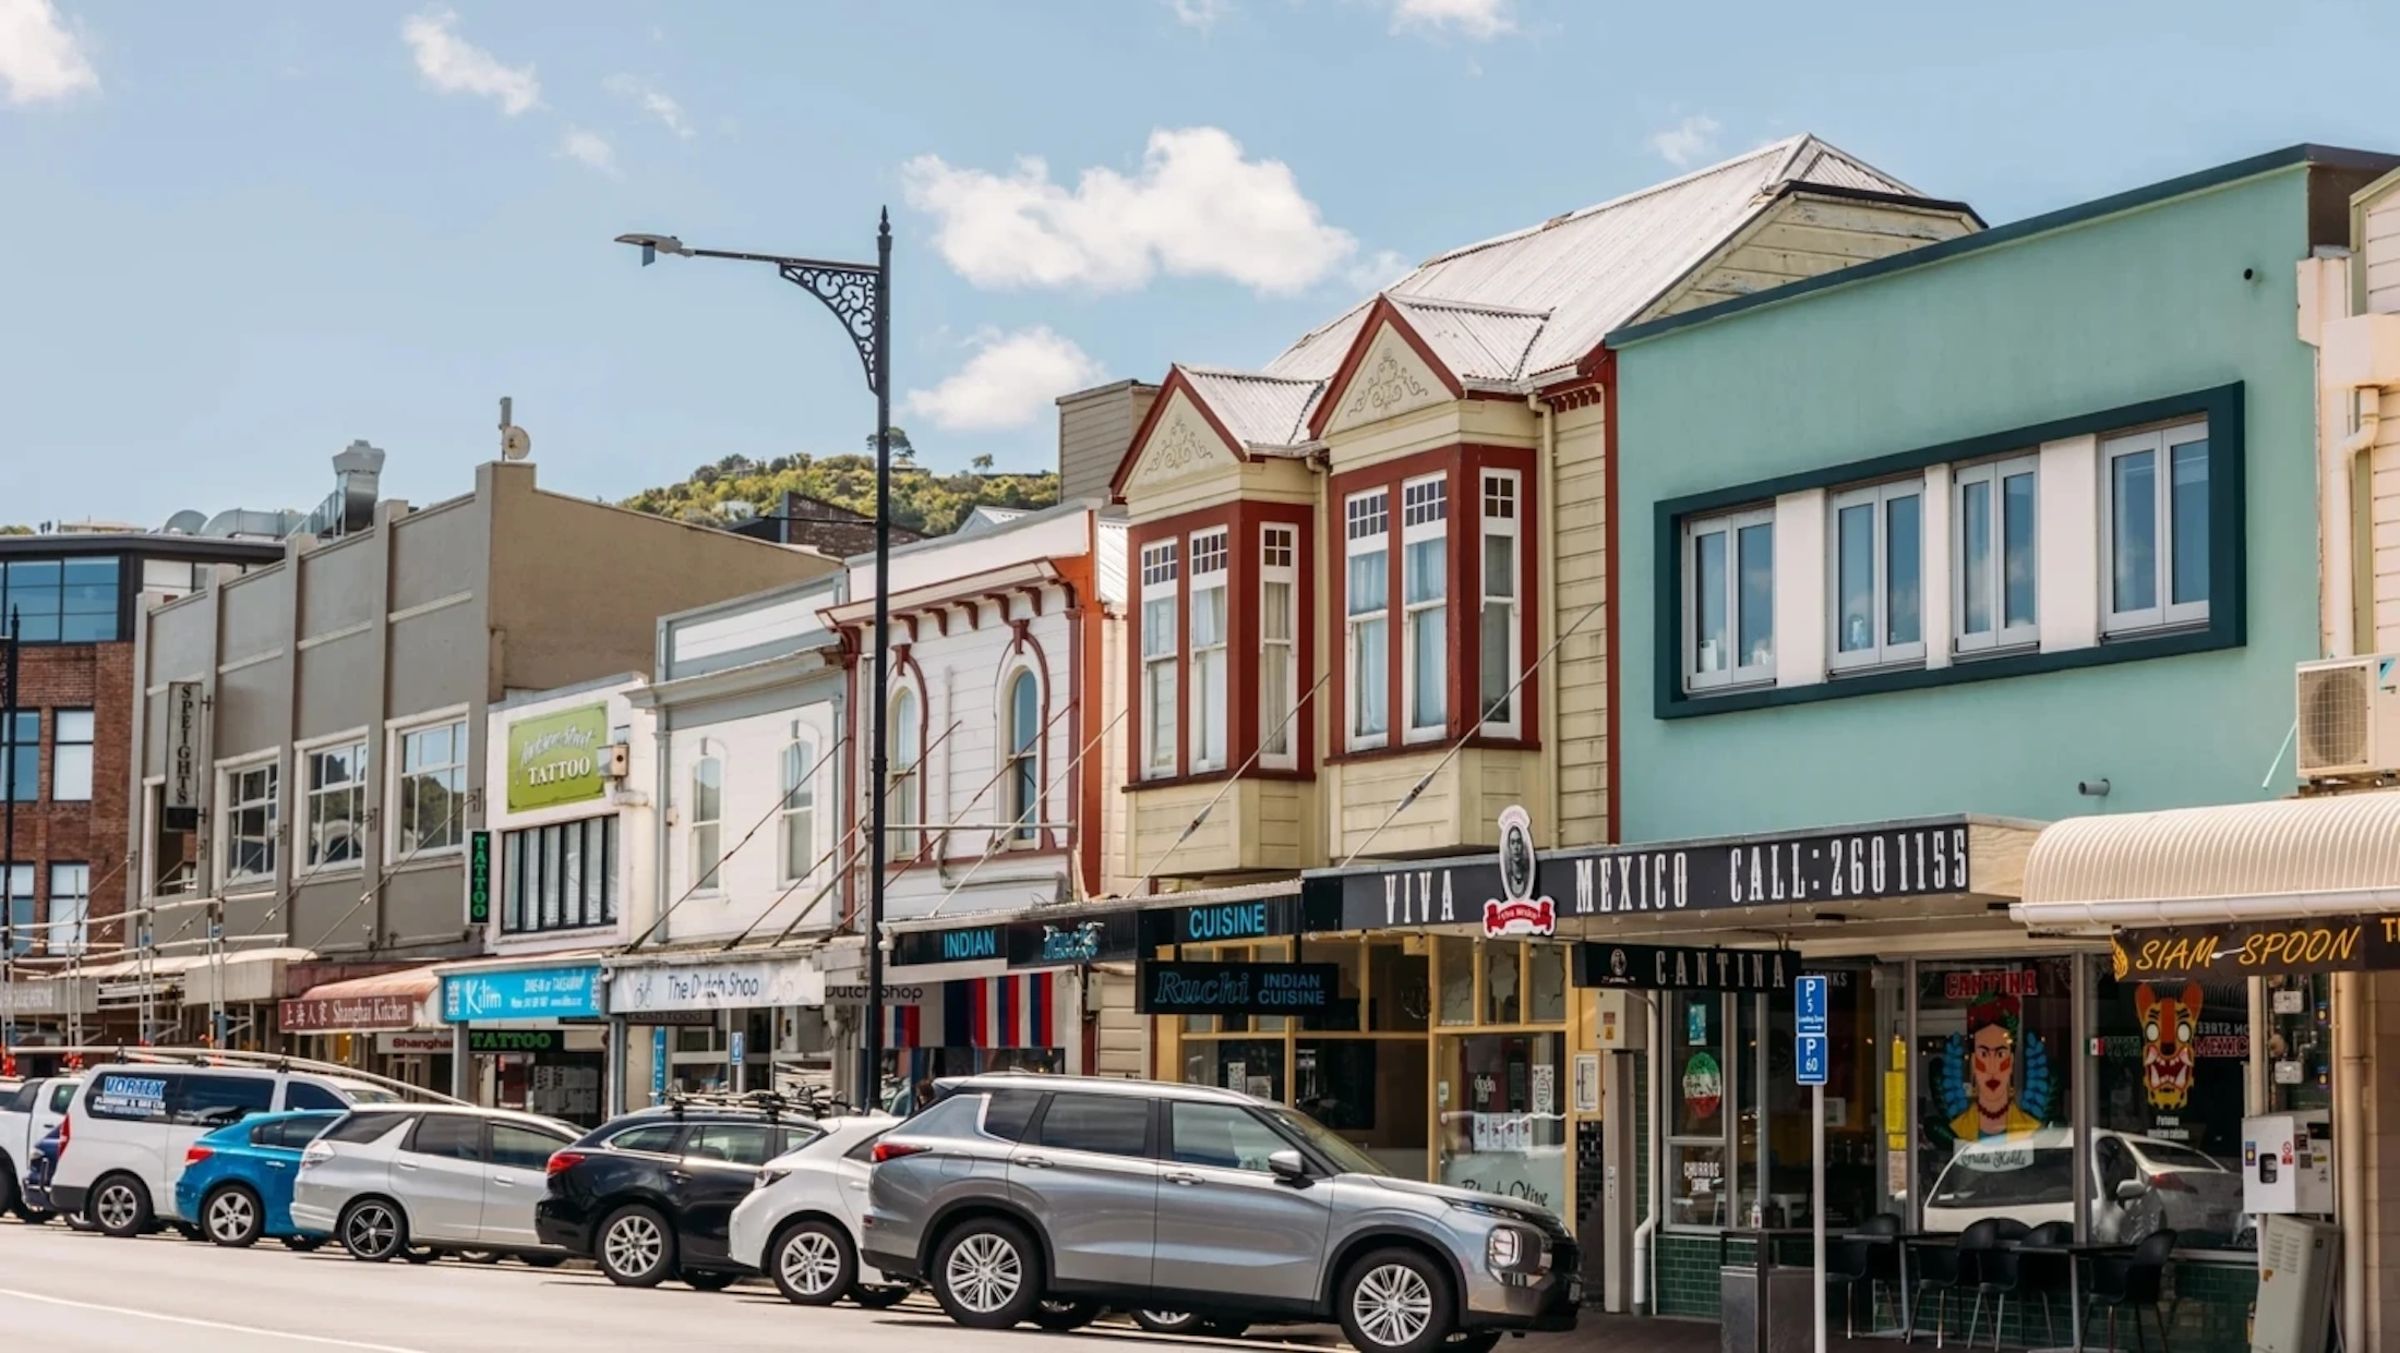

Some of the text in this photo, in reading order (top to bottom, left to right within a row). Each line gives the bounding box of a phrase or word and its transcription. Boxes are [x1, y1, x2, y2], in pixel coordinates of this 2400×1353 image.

[176, 685, 193, 804] SPEIGHTS
[528, 757, 592, 787] TATTOO
[473, 835, 487, 918] TATTOO
[1384, 870, 1454, 924] VIVA
[1576, 852, 1687, 913] MEXICO
[1188, 903, 1265, 939] CUISINE
[2381, 918, 2400, 942] T
[944, 930, 995, 959] INDIAN
[2136, 925, 2361, 971] SIAM SPOON
[1263, 973, 1321, 988] INDIAN
[1656, 950, 1786, 988] CANTINA
[466, 978, 502, 1015] Kilim
[668, 975, 689, 1000] The
[728, 970, 760, 999] Shop
[1154, 971, 1250, 1005] Ruchi
[1257, 991, 1326, 1005] CUISINE
[1805, 980, 1816, 998] P
[1944, 970, 2039, 999] CANTINA
[332, 998, 408, 1026] Shanghai Kitchen
[1807, 998, 1814, 1013] 5
[471, 1032, 551, 1049] TATTOO
[1806, 1038, 1817, 1056] P
[1805, 1057, 1819, 1072] 60
[105, 1076, 167, 1098] VORTEX
